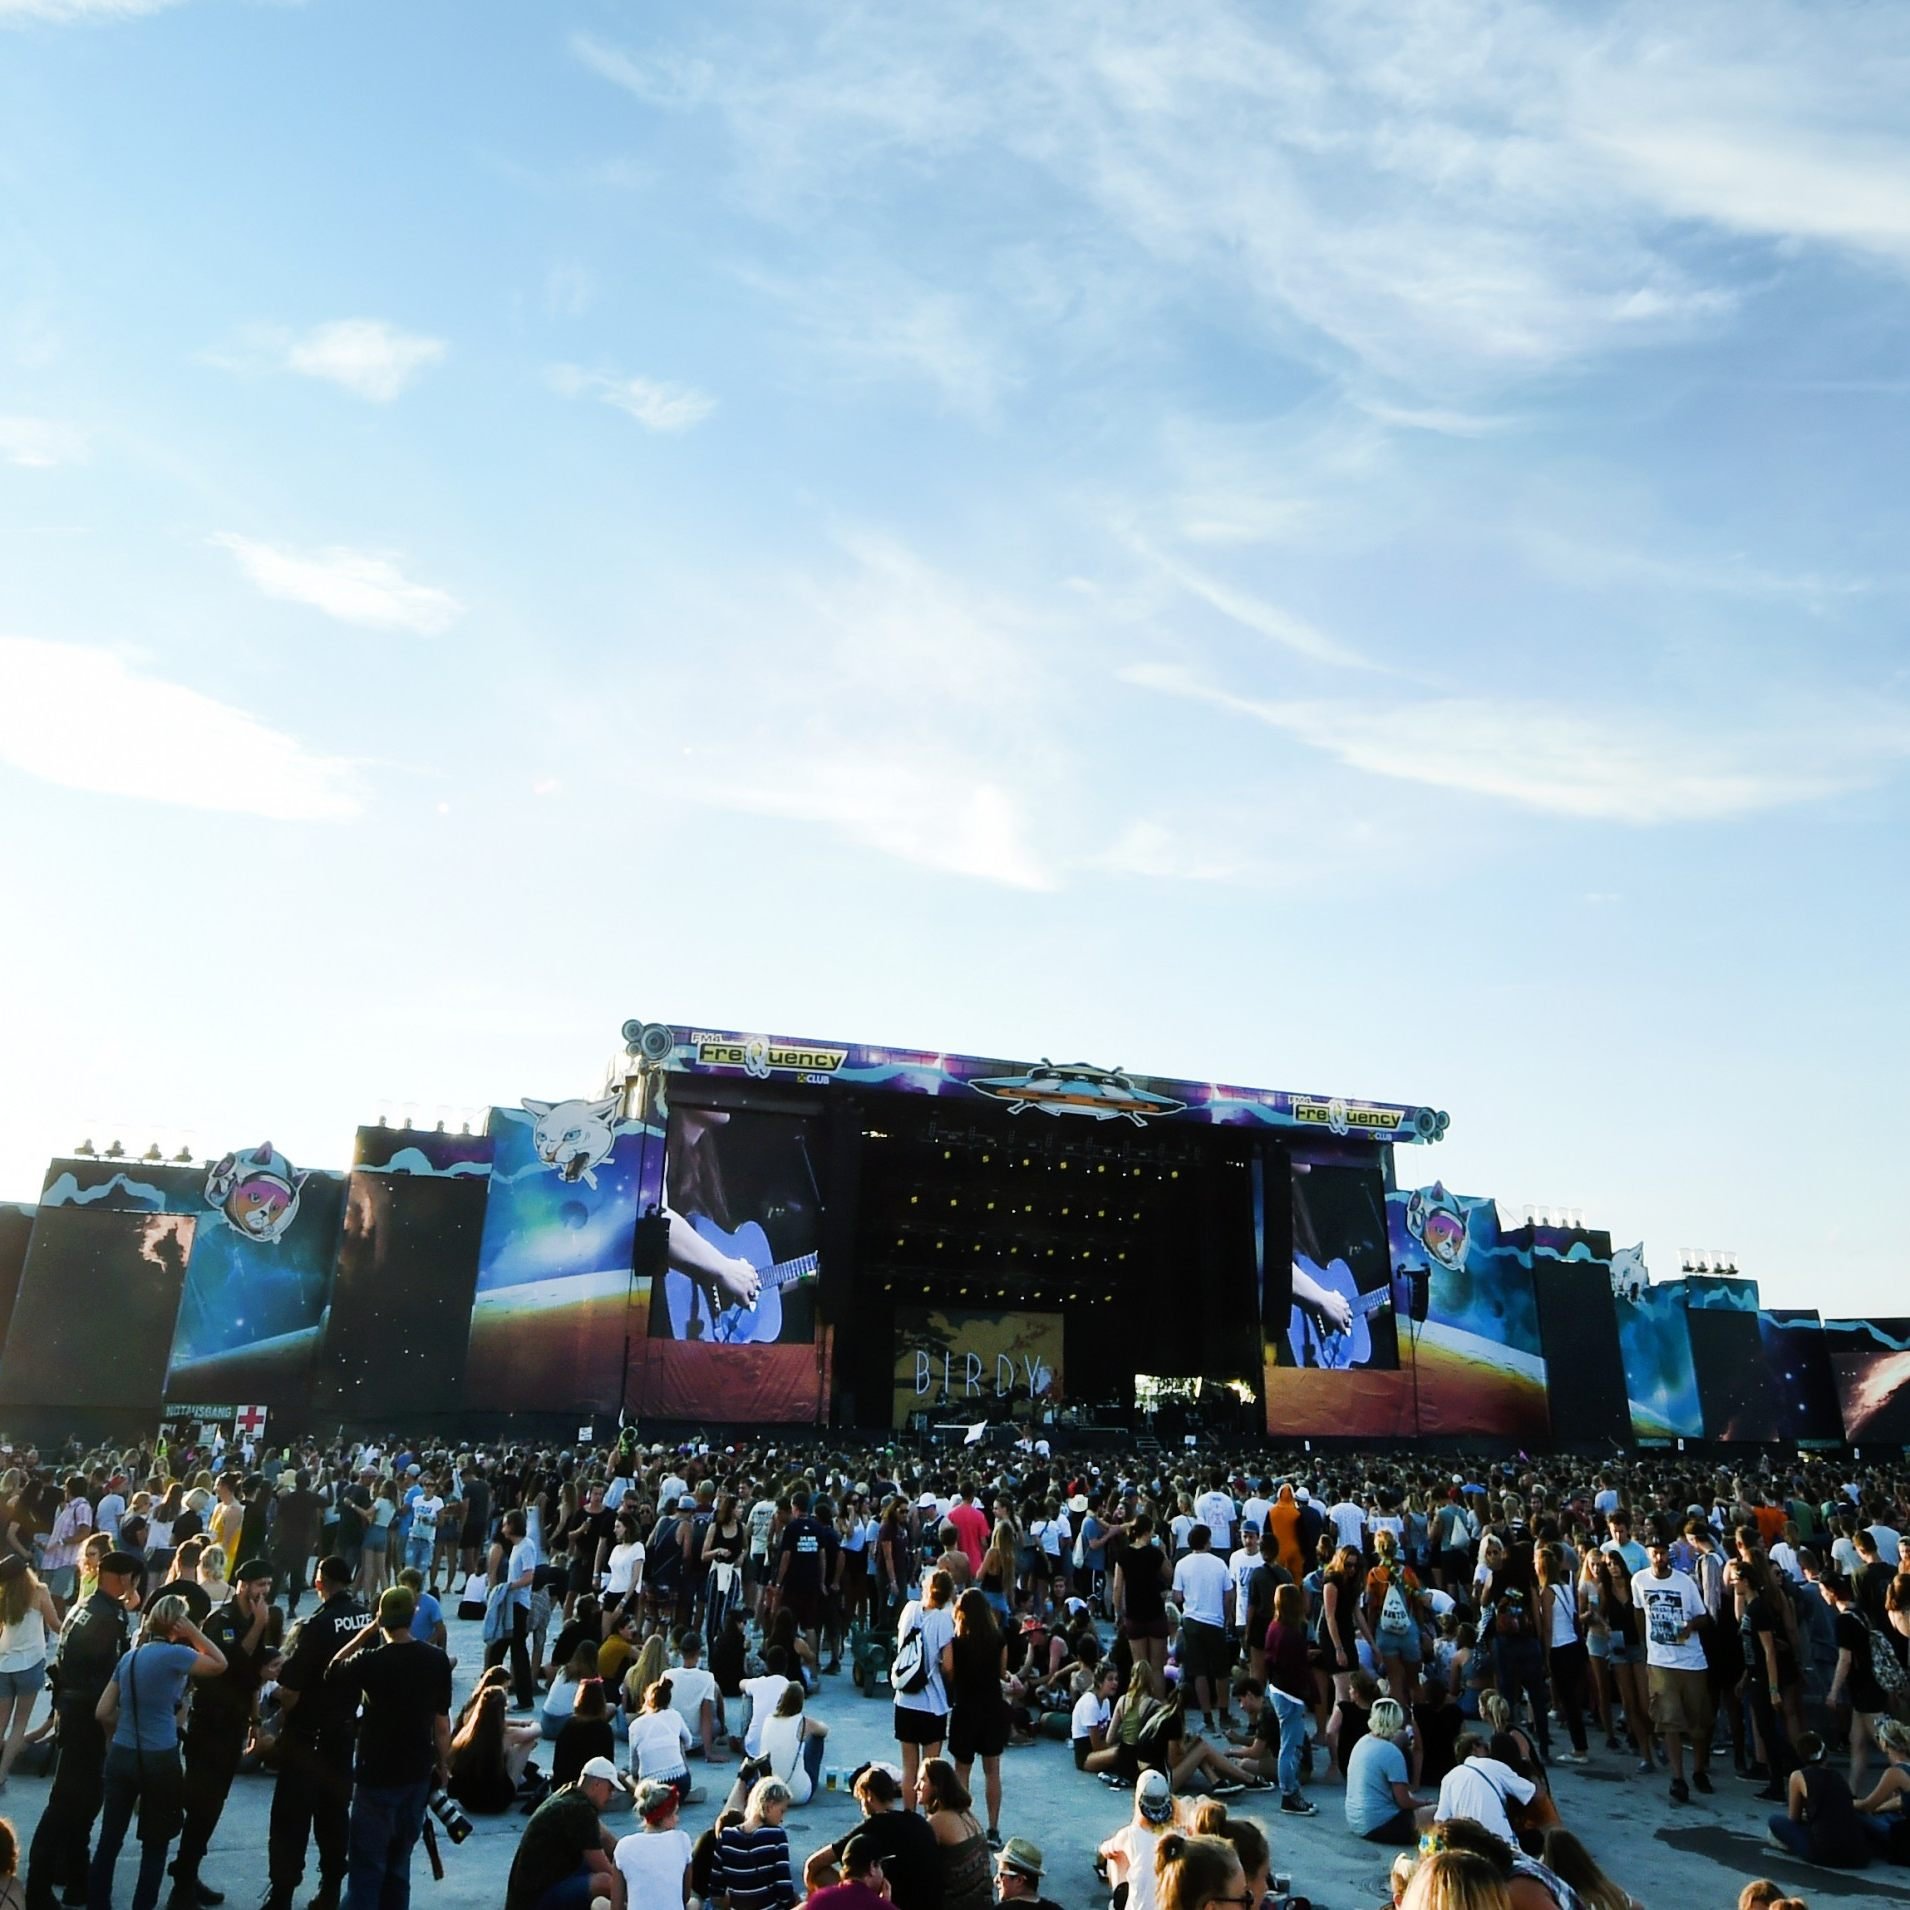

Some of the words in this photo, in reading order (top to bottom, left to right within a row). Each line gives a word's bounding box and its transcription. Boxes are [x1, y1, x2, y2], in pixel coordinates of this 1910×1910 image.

[692, 1032, 722, 1043] FM4
[700, 1038, 843, 1077] FreQuency
[1295, 1099, 1401, 1135] FreQuency
[916, 1350, 1041, 1398] BIRDY
[166, 1404, 232, 1418] NOTAUSGANG
[334, 1613, 373, 1633] POLIZE
